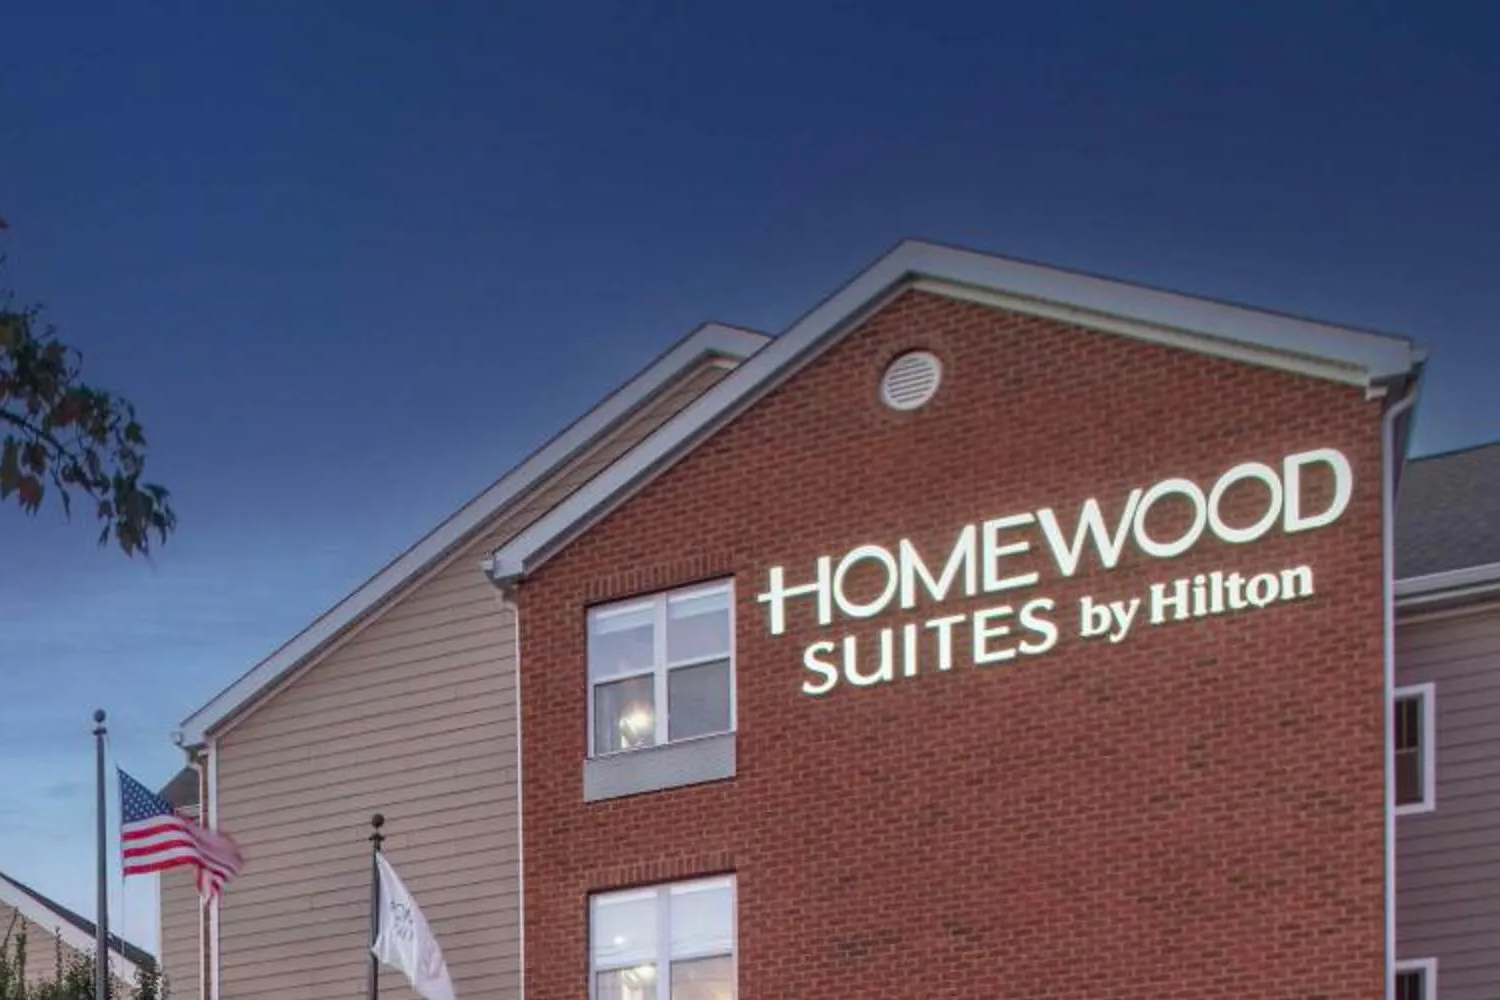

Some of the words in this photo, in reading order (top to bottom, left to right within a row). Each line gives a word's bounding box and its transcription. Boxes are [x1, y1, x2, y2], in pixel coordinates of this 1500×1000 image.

[757, 447, 1353, 635] HOMEWOOD
[801, 597, 1059, 695] SUITES
[1079, 595, 1141, 643] by
[1149, 564, 1314, 625] Hilton
